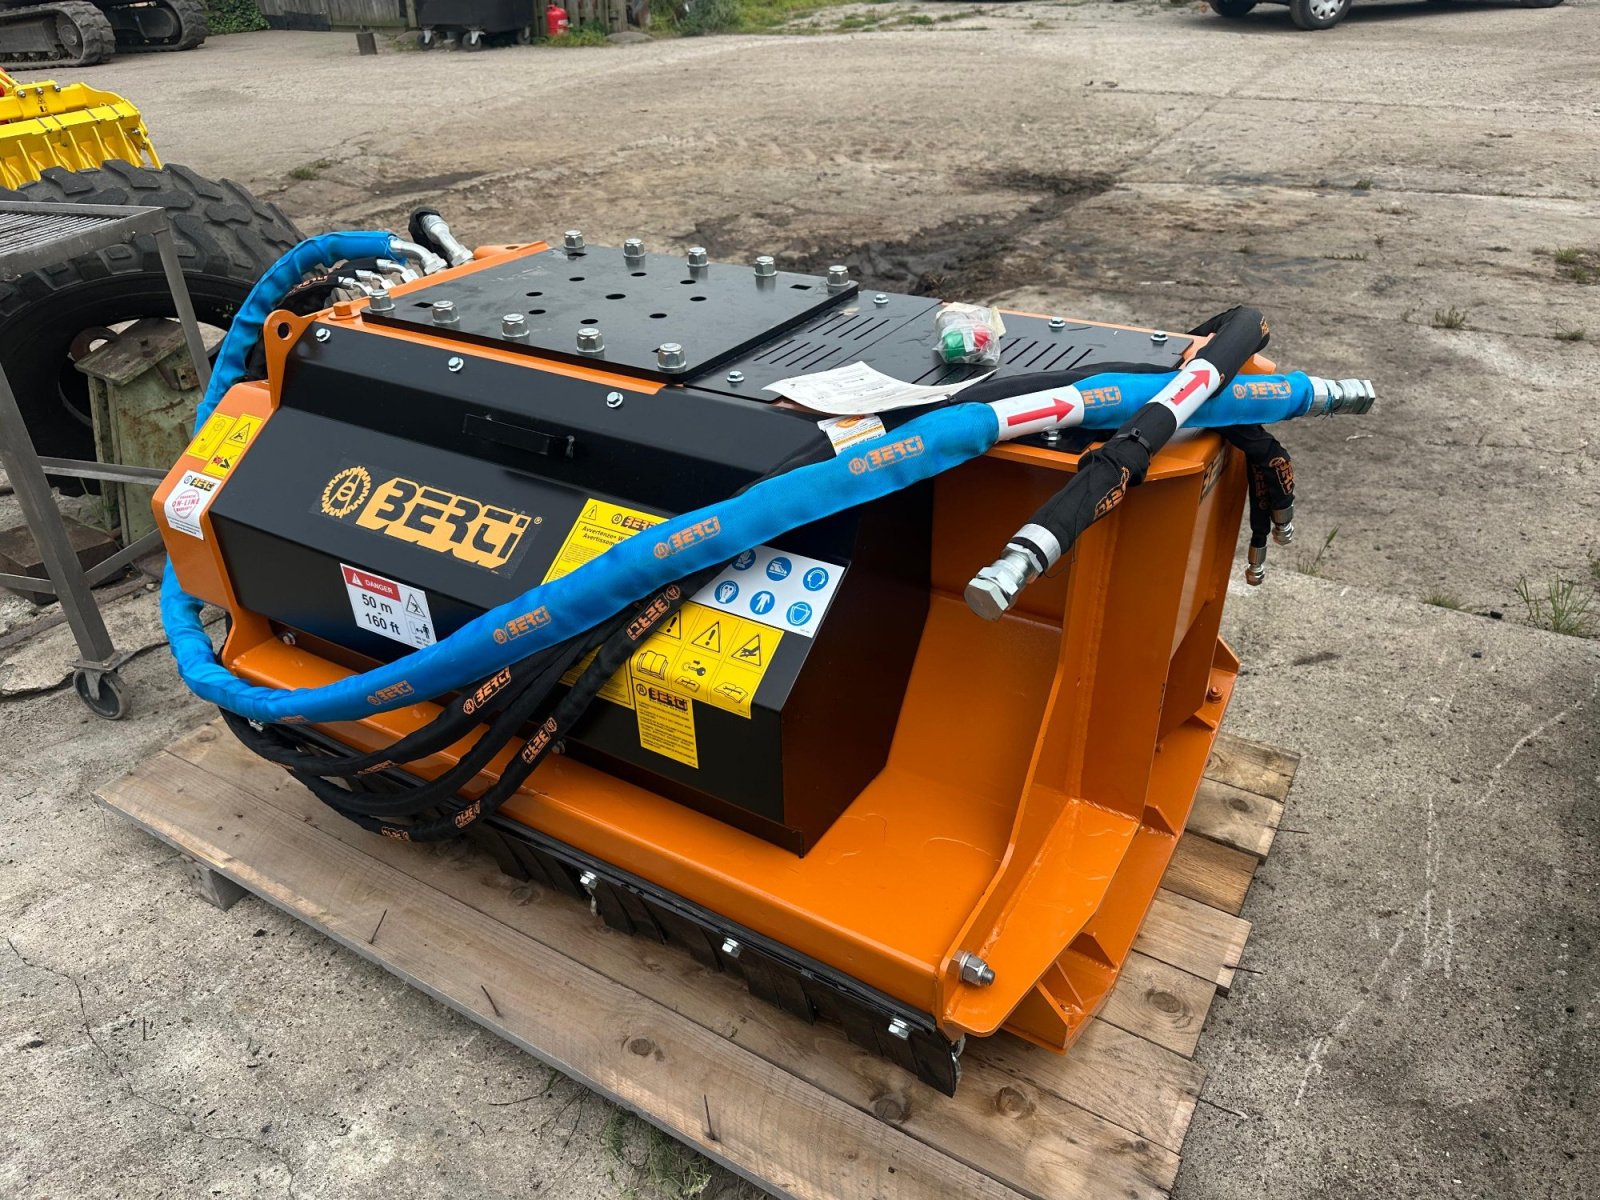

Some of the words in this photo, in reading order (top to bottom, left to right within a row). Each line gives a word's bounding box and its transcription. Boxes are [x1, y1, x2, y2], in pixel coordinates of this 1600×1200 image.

[364, 579, 394, 594] DANGER
[361, 593, 377, 609] 50
[380, 602, 393, 615] m
[365, 612, 387, 630] 160
[390, 621, 401, 635] ft
